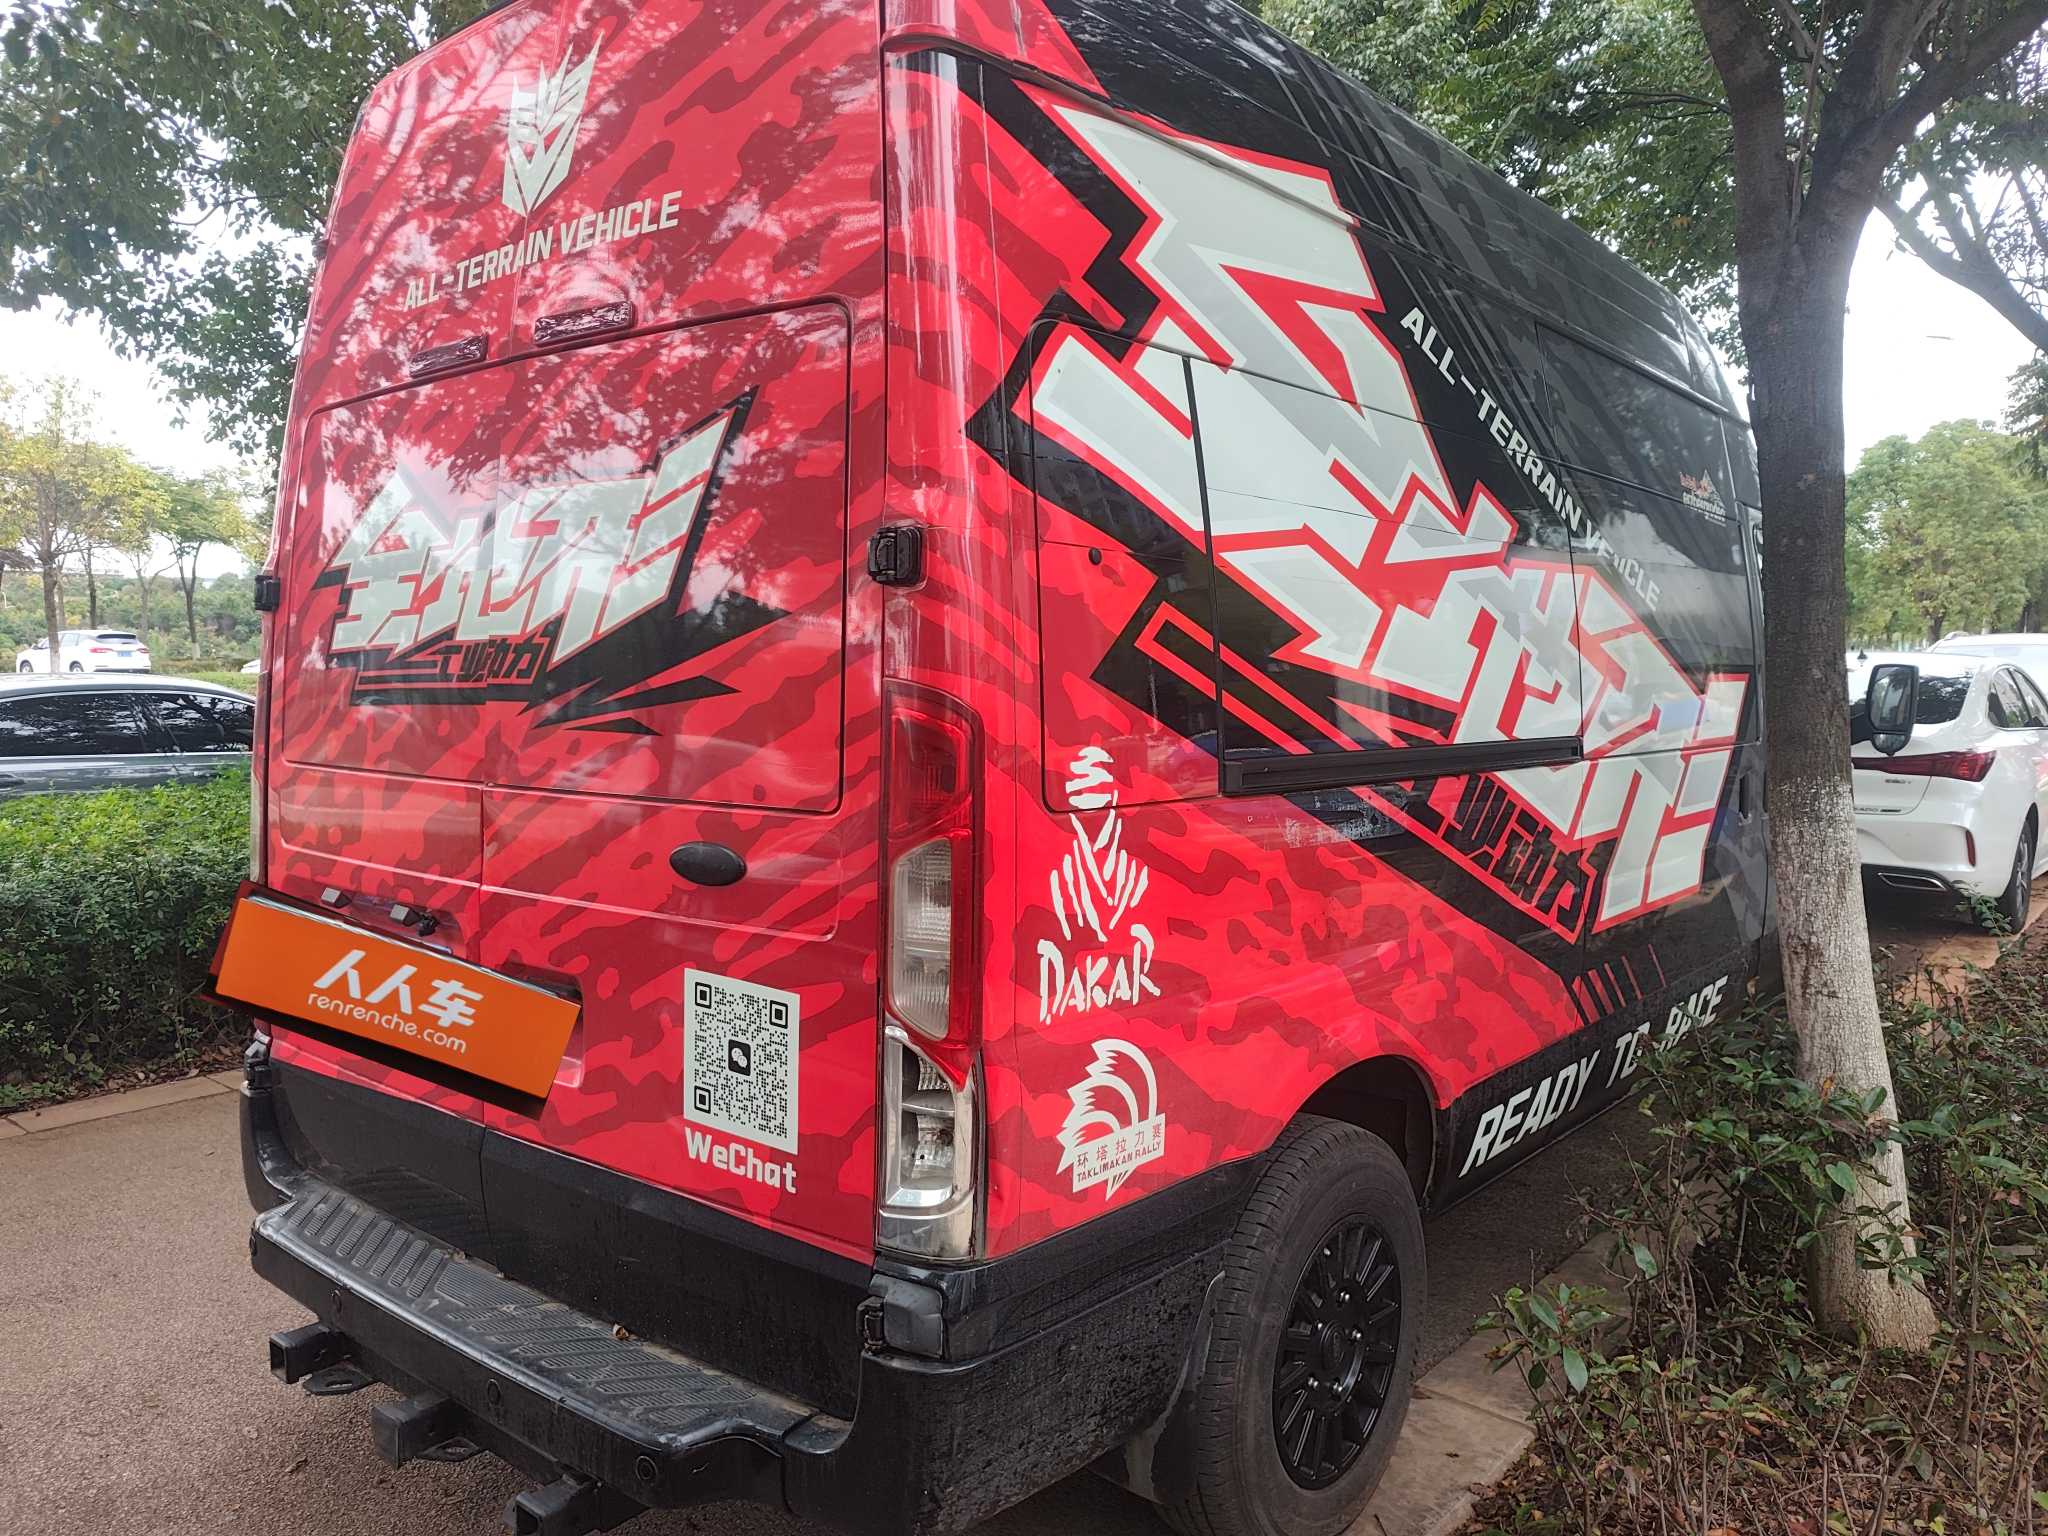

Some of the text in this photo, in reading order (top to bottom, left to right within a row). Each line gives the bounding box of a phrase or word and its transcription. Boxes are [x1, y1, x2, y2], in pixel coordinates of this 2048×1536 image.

[404, 191, 682, 312] ALL-TERRAIN VEHICLE
[1400, 307, 1582, 531] ALL-TERRAIN
[1037, 924, 1161, 1024] DAKAR
[684, 1126, 797, 1194] WeChat
[1077, 1122, 1161, 1169] 环塔拉力赛
[1077, 1141, 1161, 1183] TAKLIMAKAN RALLY
[1458, 1050, 1600, 1179] READY
